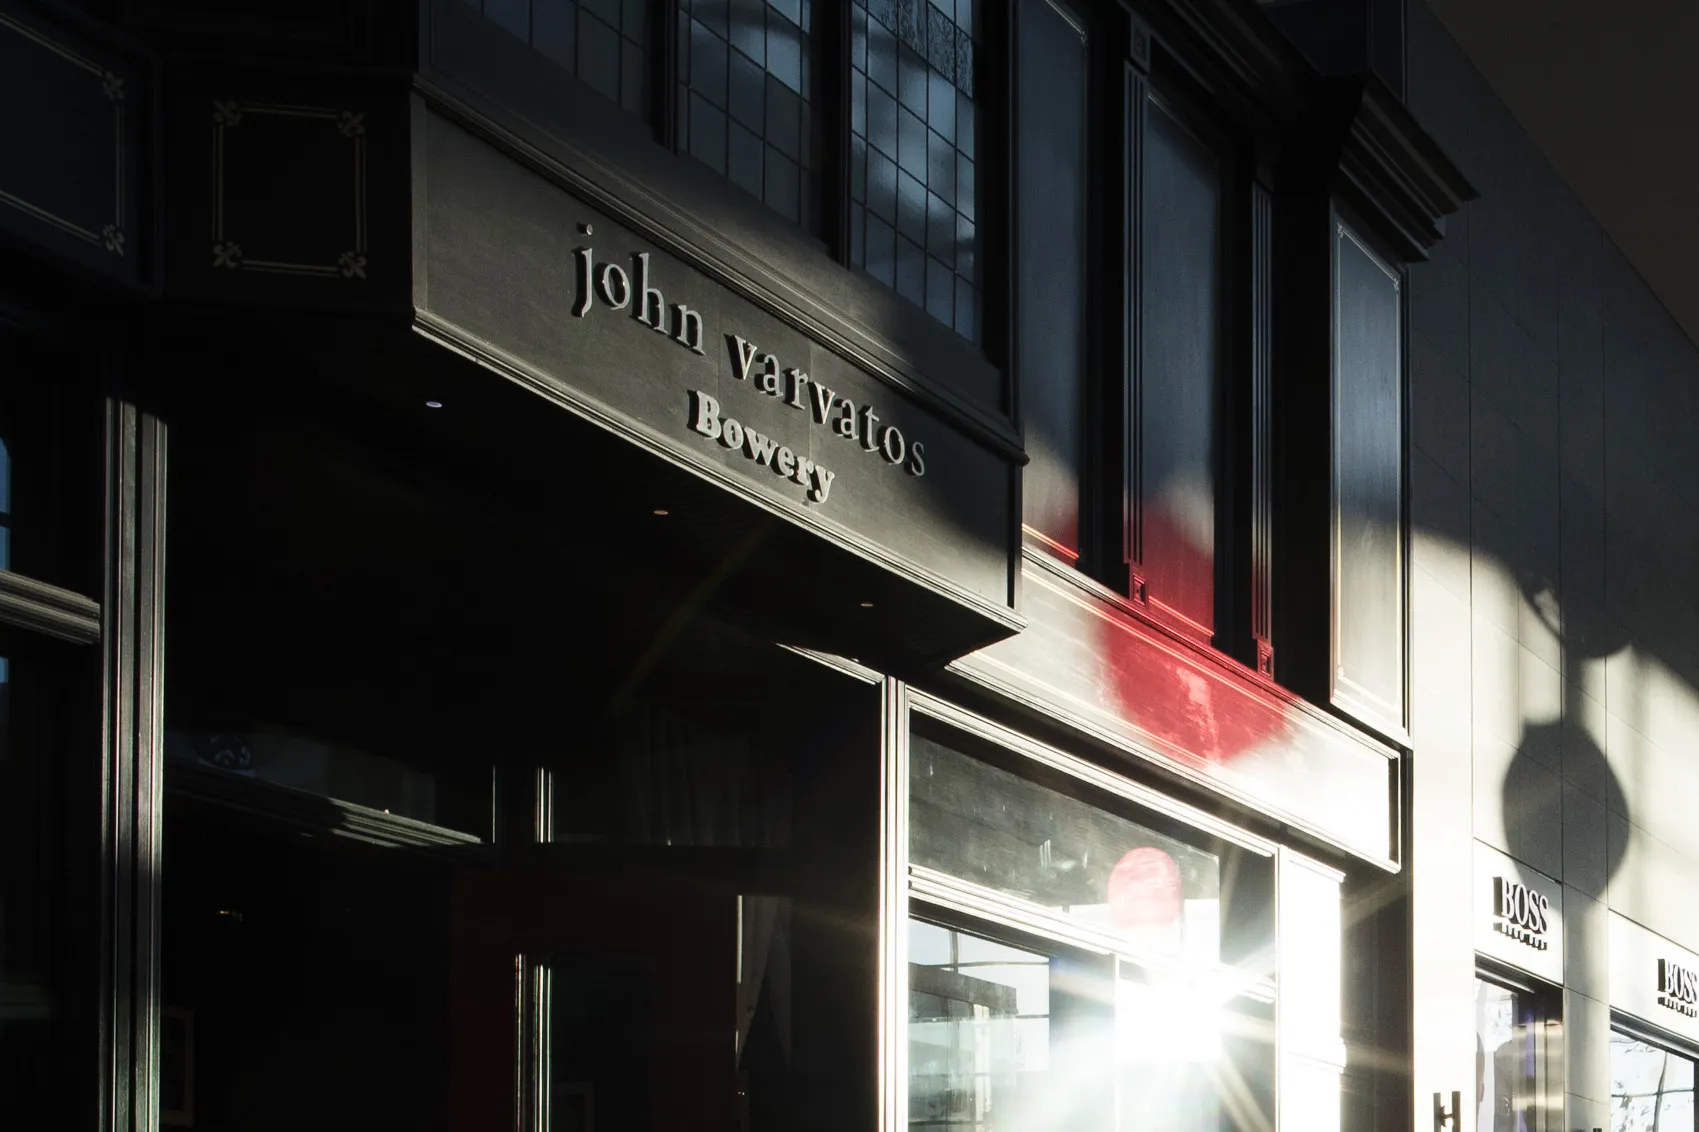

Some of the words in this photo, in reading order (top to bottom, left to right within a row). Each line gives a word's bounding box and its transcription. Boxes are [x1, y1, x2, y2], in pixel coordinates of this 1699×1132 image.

[571, 224, 706, 356] john
[725, 334, 925, 477] varvatos
[690, 390, 836, 503] Bowery
[1496, 877, 1549, 934] BOSS
[1660, 960, 1698, 1004] BOSS
